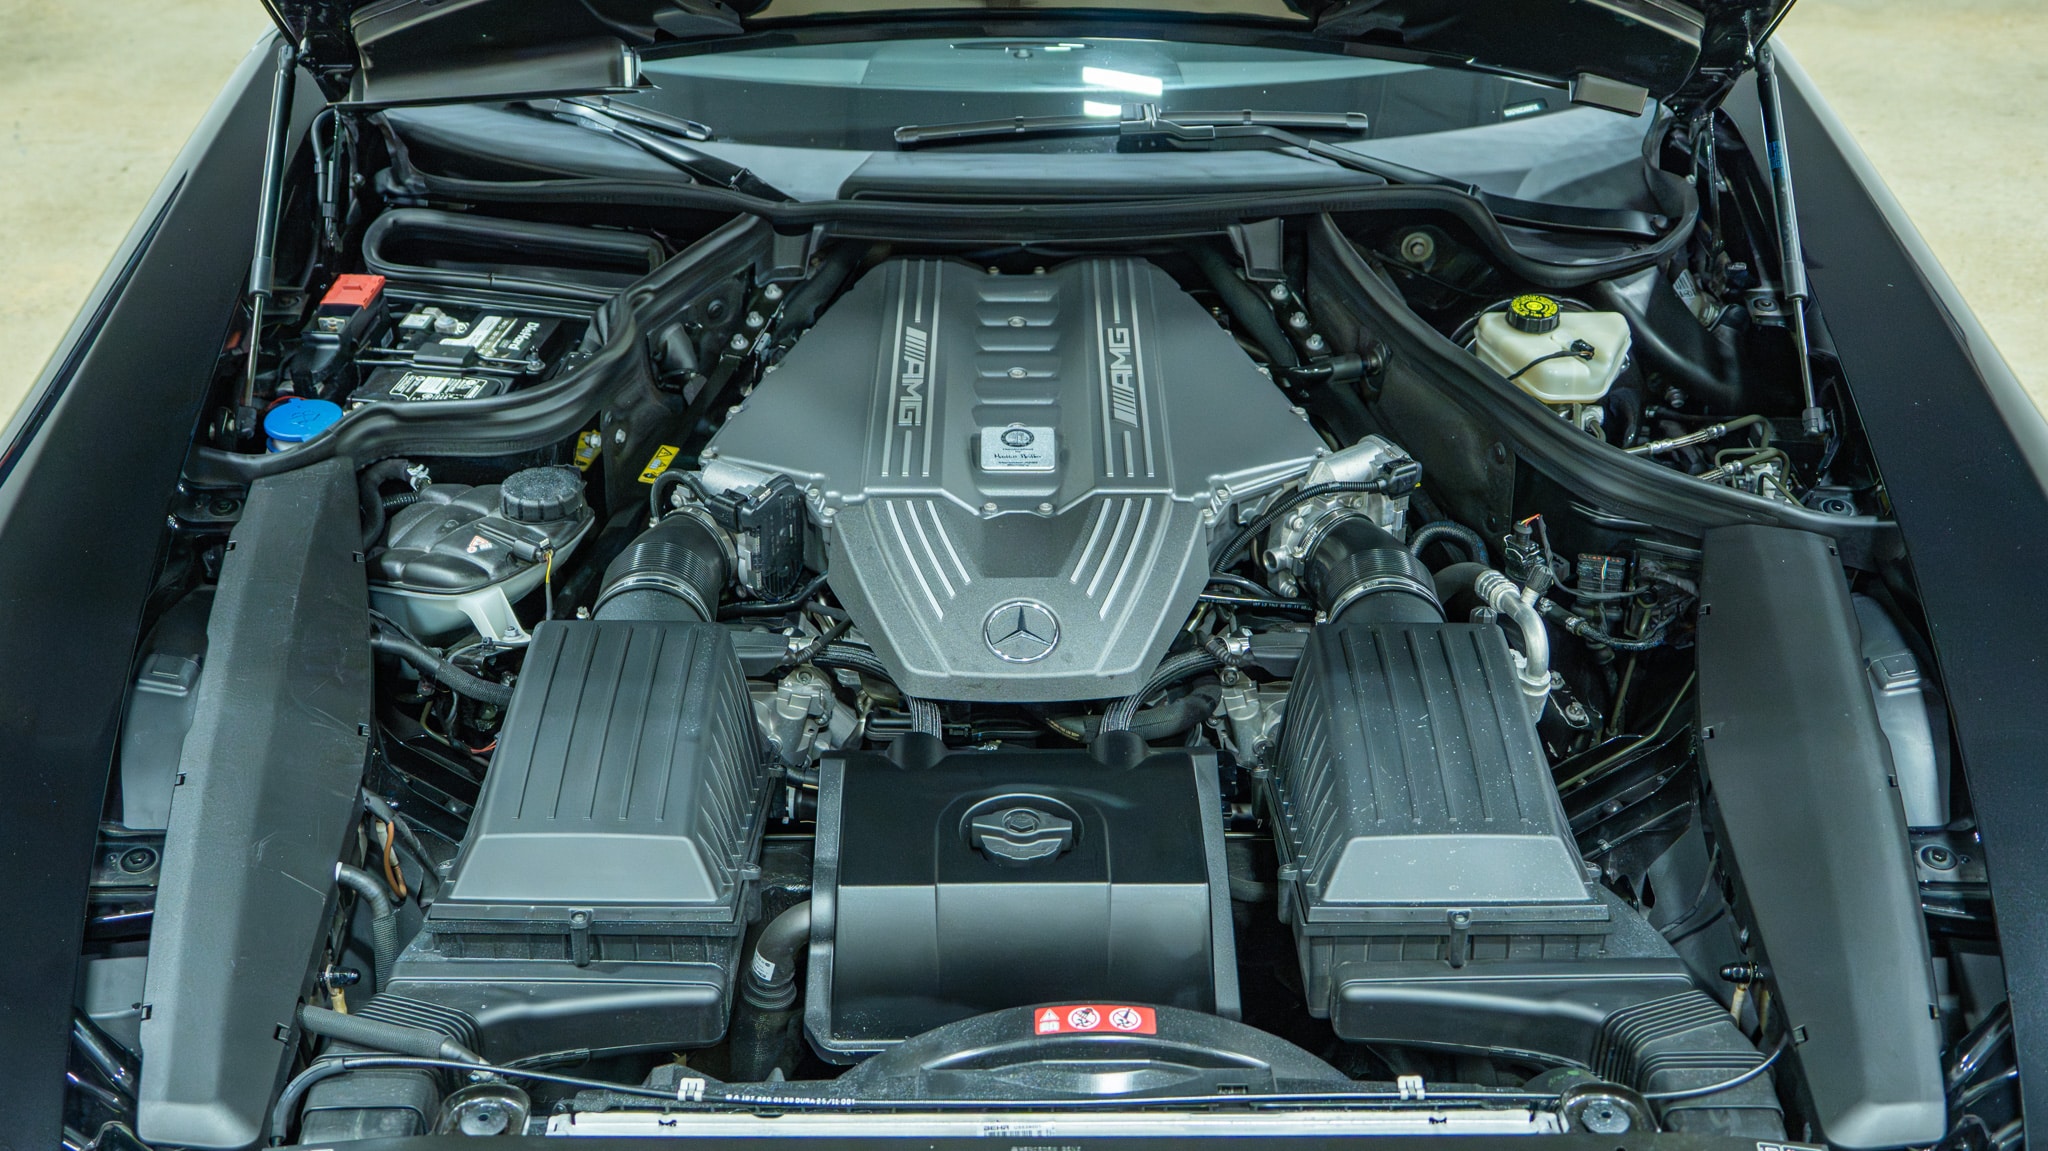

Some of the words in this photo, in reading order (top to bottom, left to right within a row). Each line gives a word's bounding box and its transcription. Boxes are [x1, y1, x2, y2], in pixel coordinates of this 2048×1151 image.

[507, 321, 540, 351] DieHard
[1107, 327, 1133, 394] AMG
[898, 357, 927, 427] AMG
